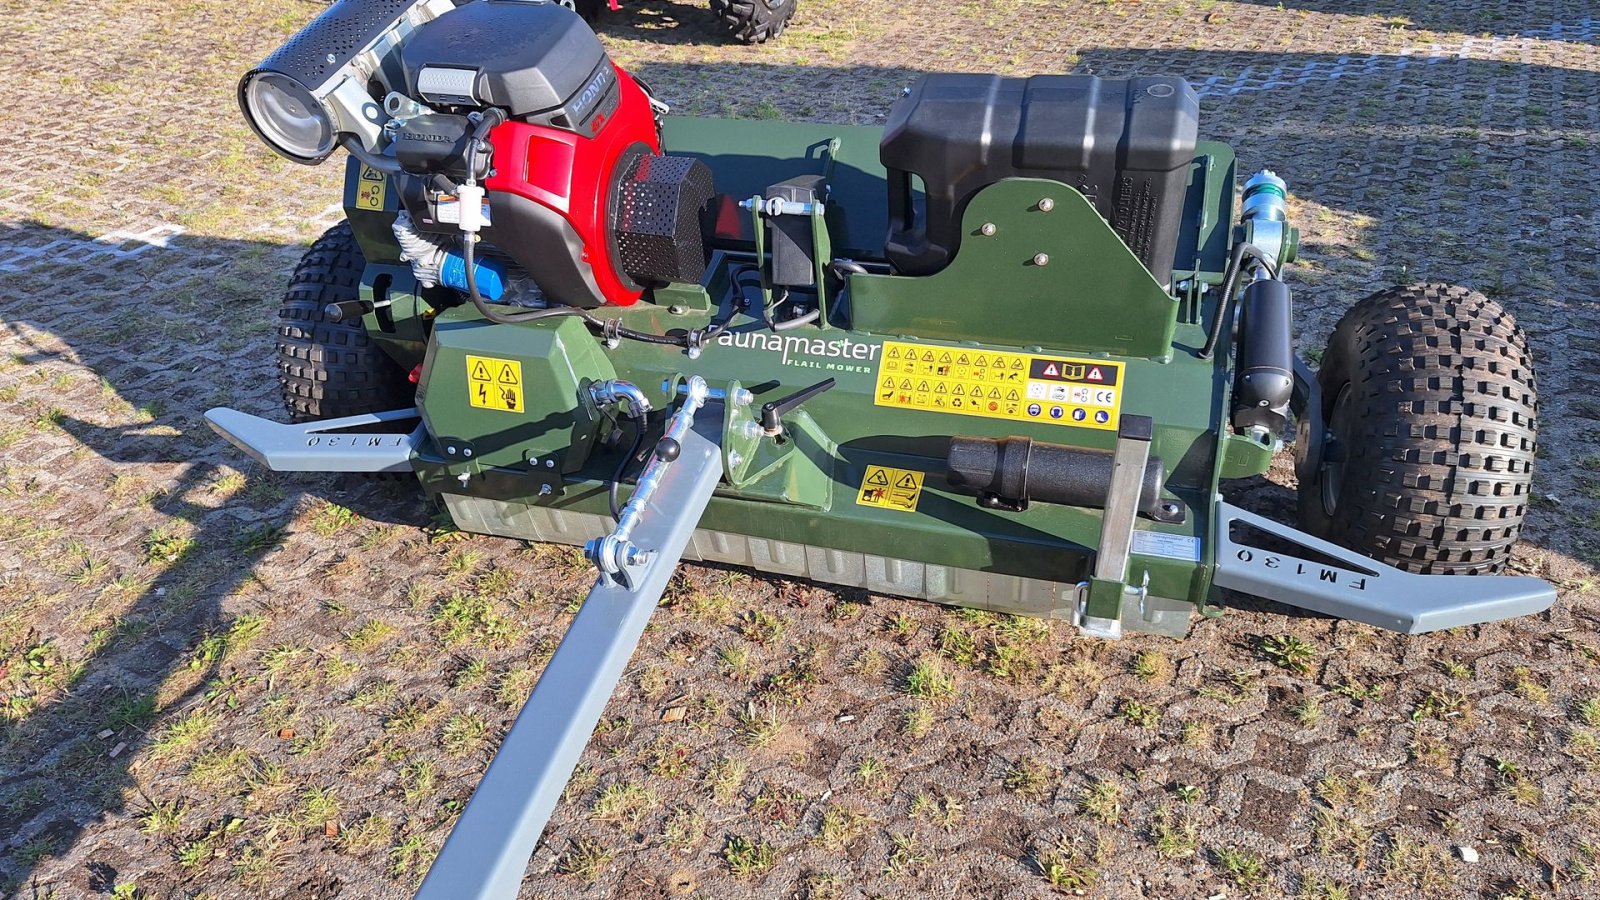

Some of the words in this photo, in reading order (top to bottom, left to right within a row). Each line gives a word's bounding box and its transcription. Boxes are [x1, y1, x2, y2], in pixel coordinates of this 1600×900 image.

[787, 359, 822, 369] FLAIL
[826, 363, 871, 374] MOWER
[1237, 549, 1366, 590] FM130
